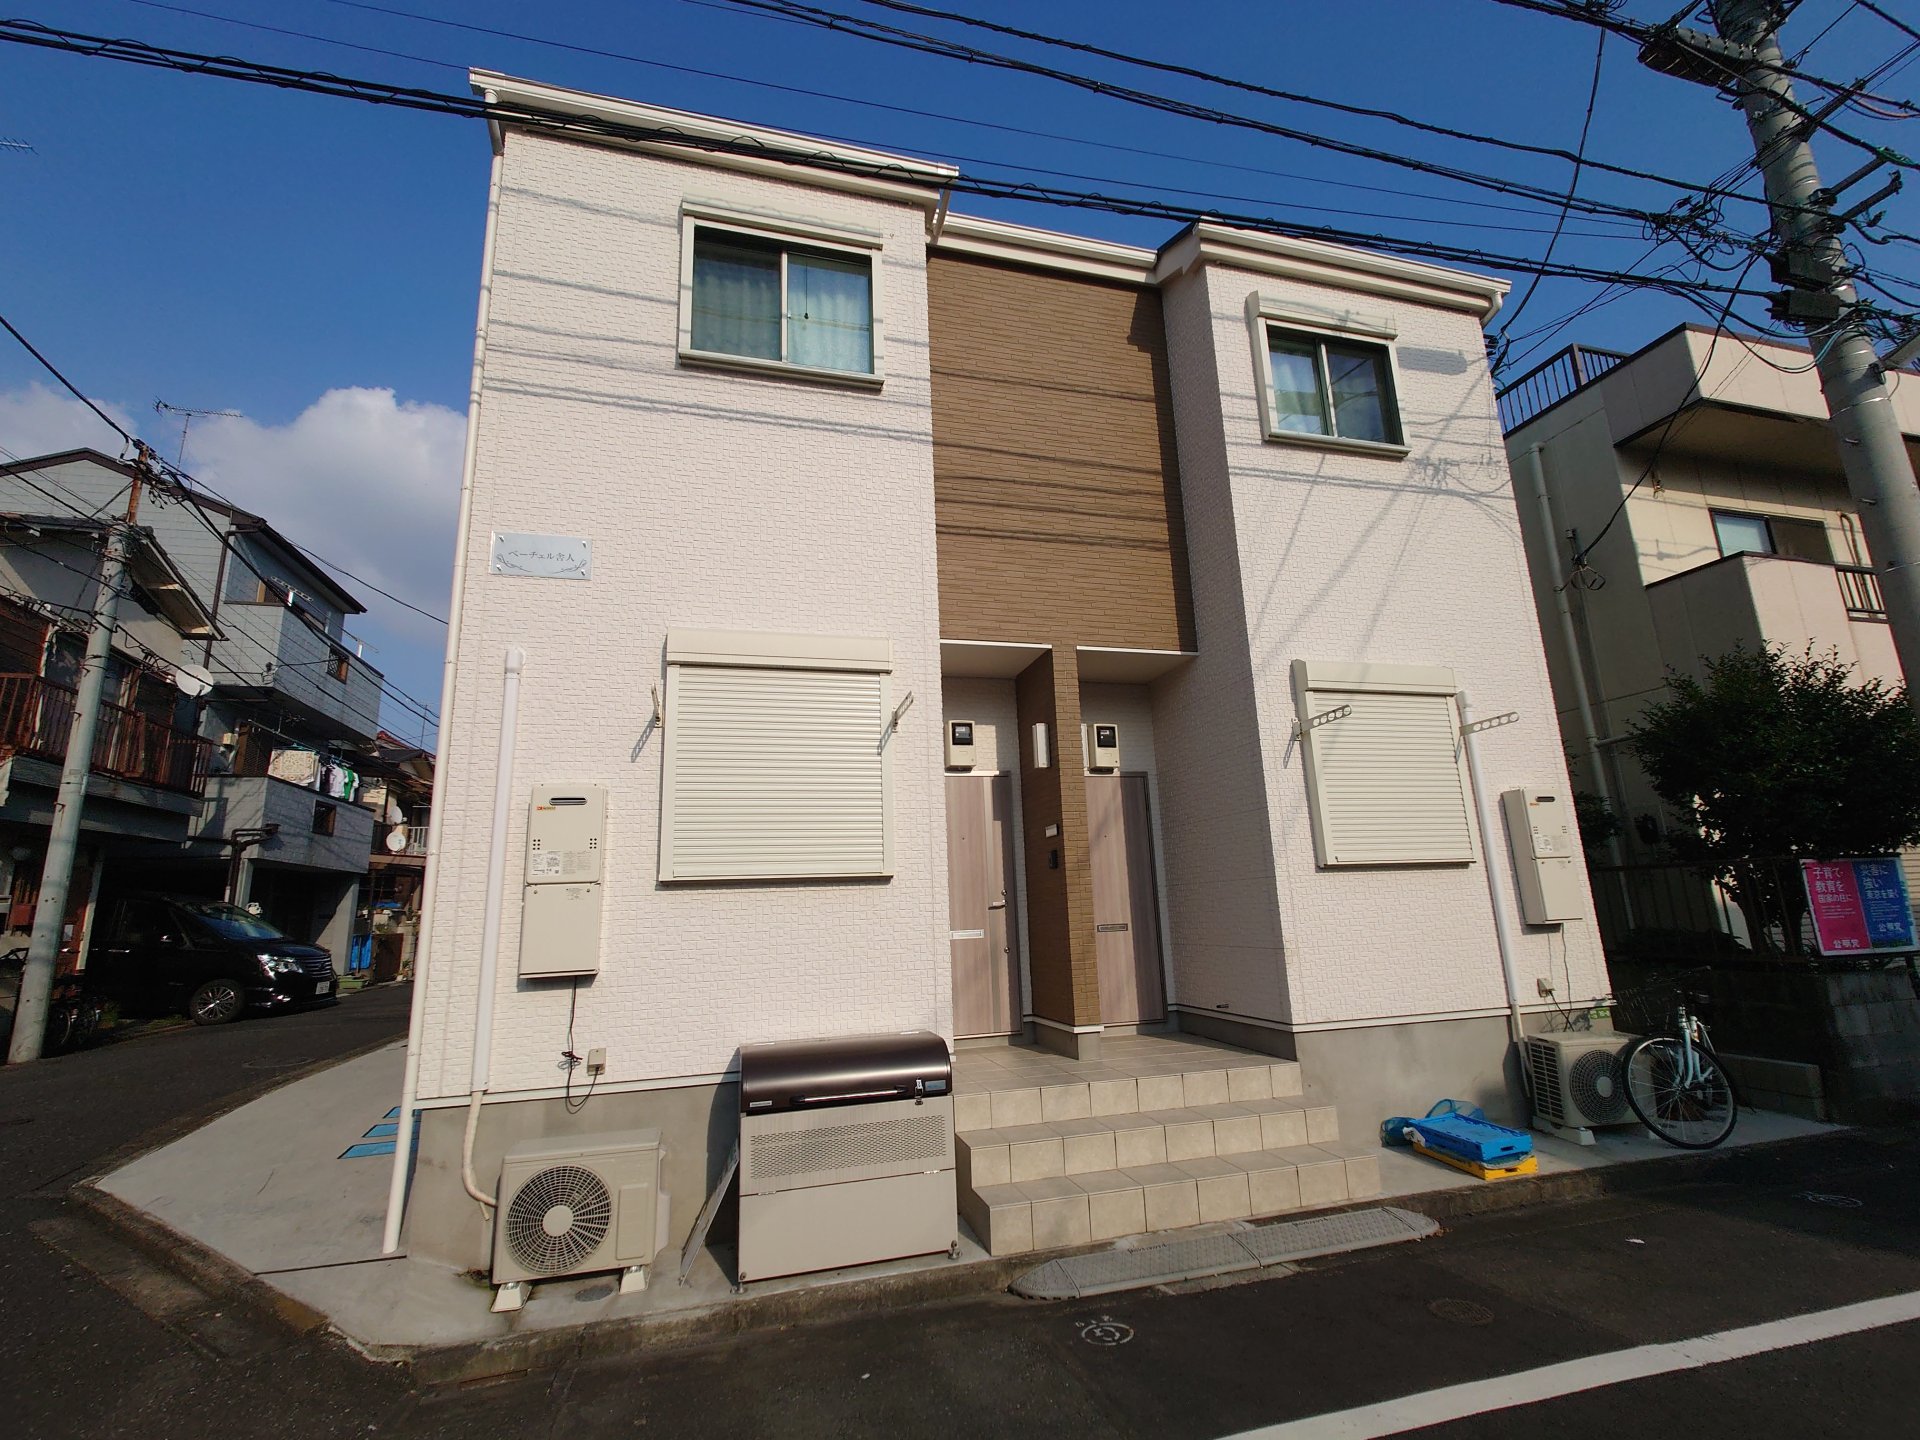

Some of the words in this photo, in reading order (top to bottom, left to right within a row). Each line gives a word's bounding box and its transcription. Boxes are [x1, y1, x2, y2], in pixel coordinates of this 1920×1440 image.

[1815, 880, 1845, 893] 教育を
[1833, 939, 1860, 949] 公明党
